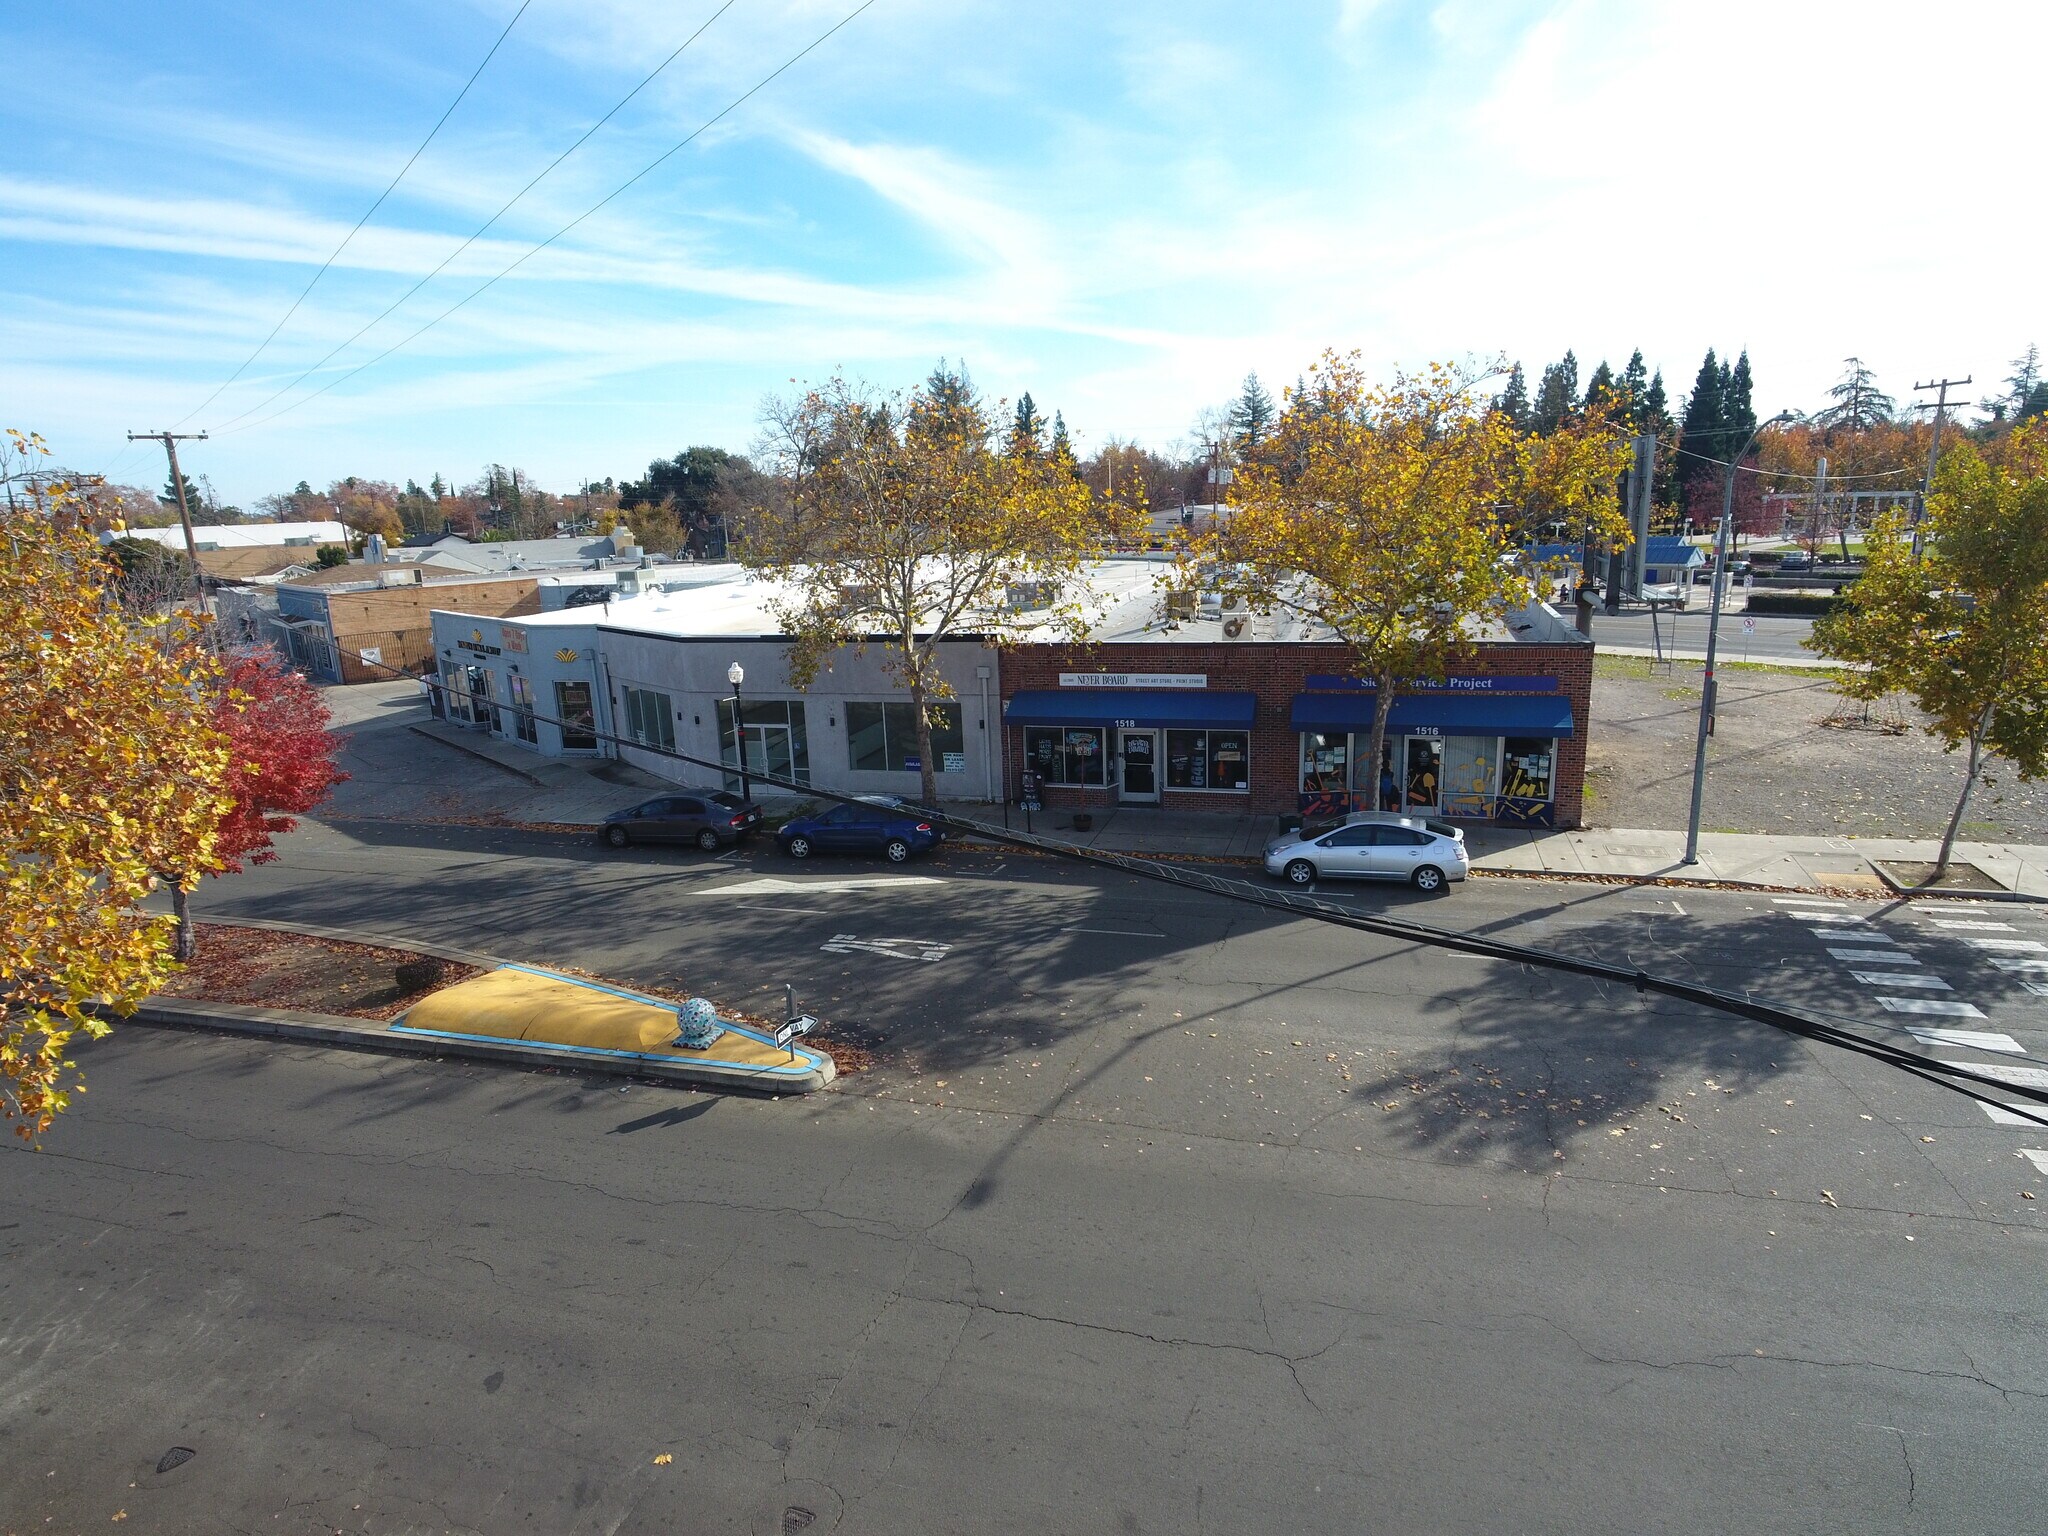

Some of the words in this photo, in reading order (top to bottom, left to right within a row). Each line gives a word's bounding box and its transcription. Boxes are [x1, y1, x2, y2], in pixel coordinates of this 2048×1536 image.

[1077, 675, 1100, 685] NEVER
[1102, 675, 1128, 685] BOARD
[1450, 677, 1492, 690] Project
[1114, 719, 1136, 728] 1518
[1415, 726, 1439, 736] 1516
